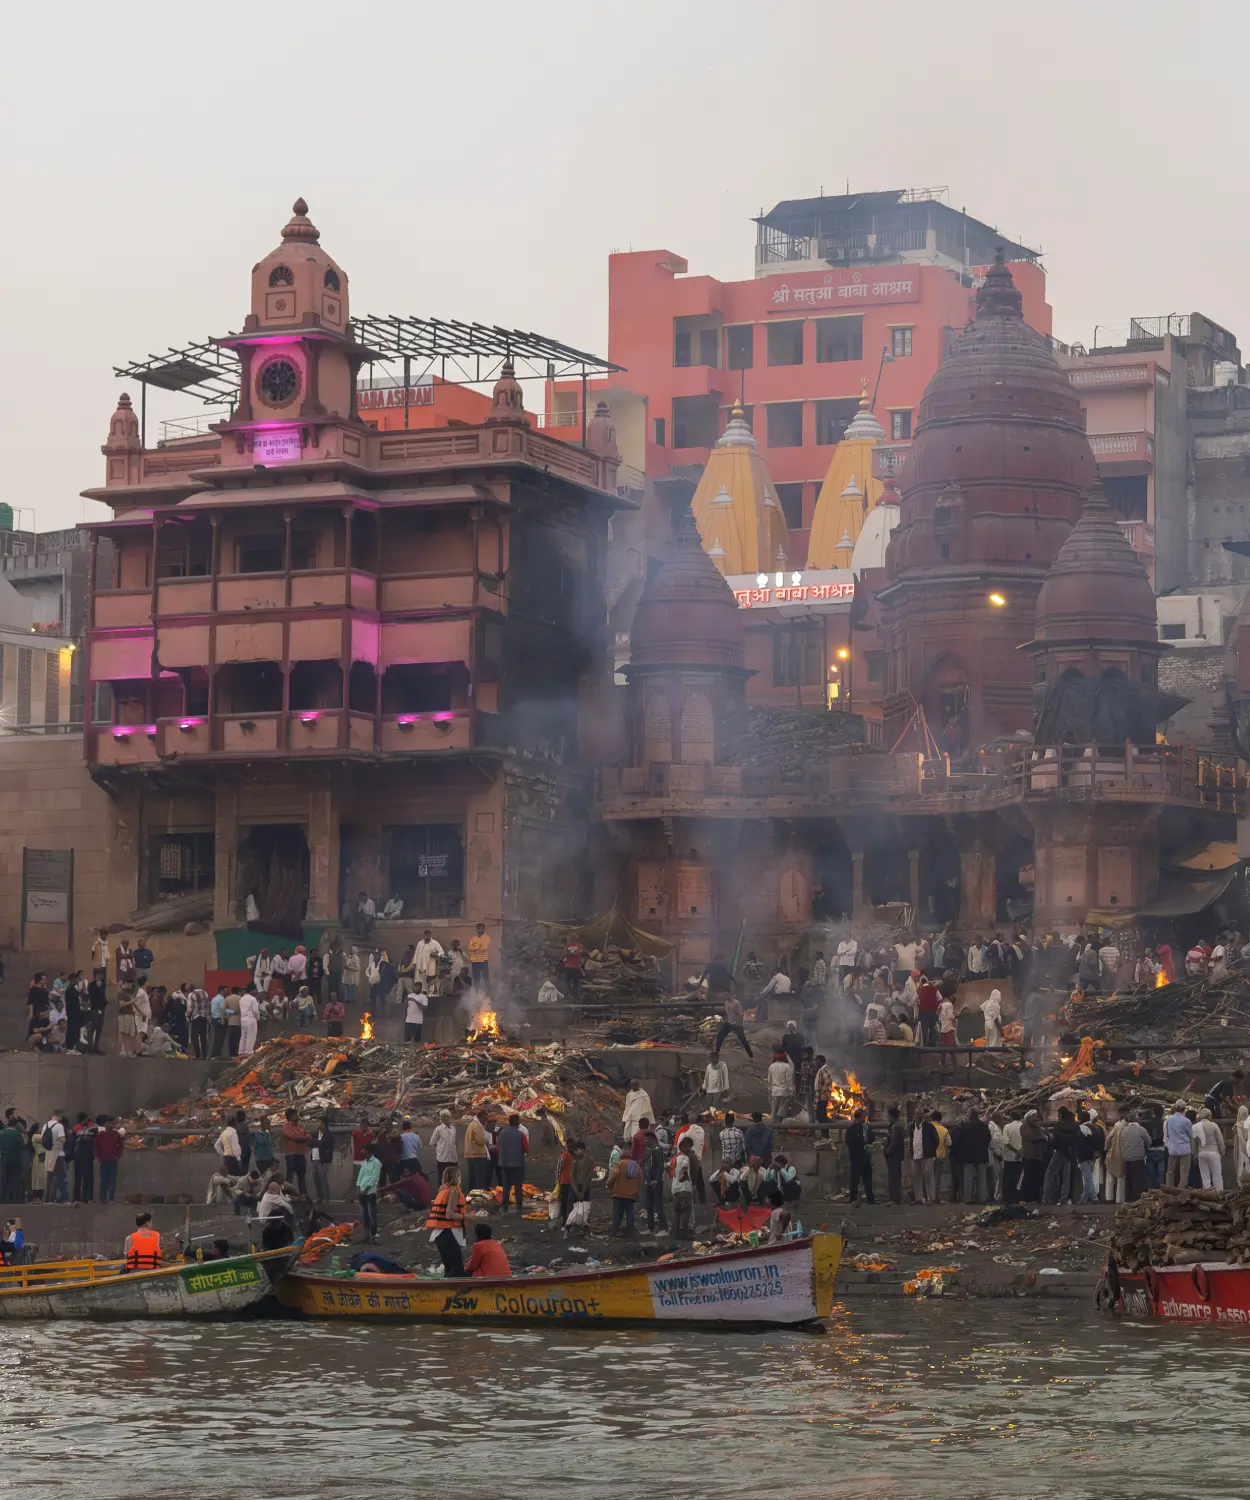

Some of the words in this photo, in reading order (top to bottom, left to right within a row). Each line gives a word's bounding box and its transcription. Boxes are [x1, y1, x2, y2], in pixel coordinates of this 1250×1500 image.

[772, 284, 790, 304] श्री
[837, 284, 868, 298] बाबा
[872, 280, 912, 296] आश्रम
[775, 585, 808, 601] बाबा
[810, 583, 855, 600] आश्रम
[189, 1268, 237, 1290] सीएनजी
[366, 1291, 381, 1309] की
